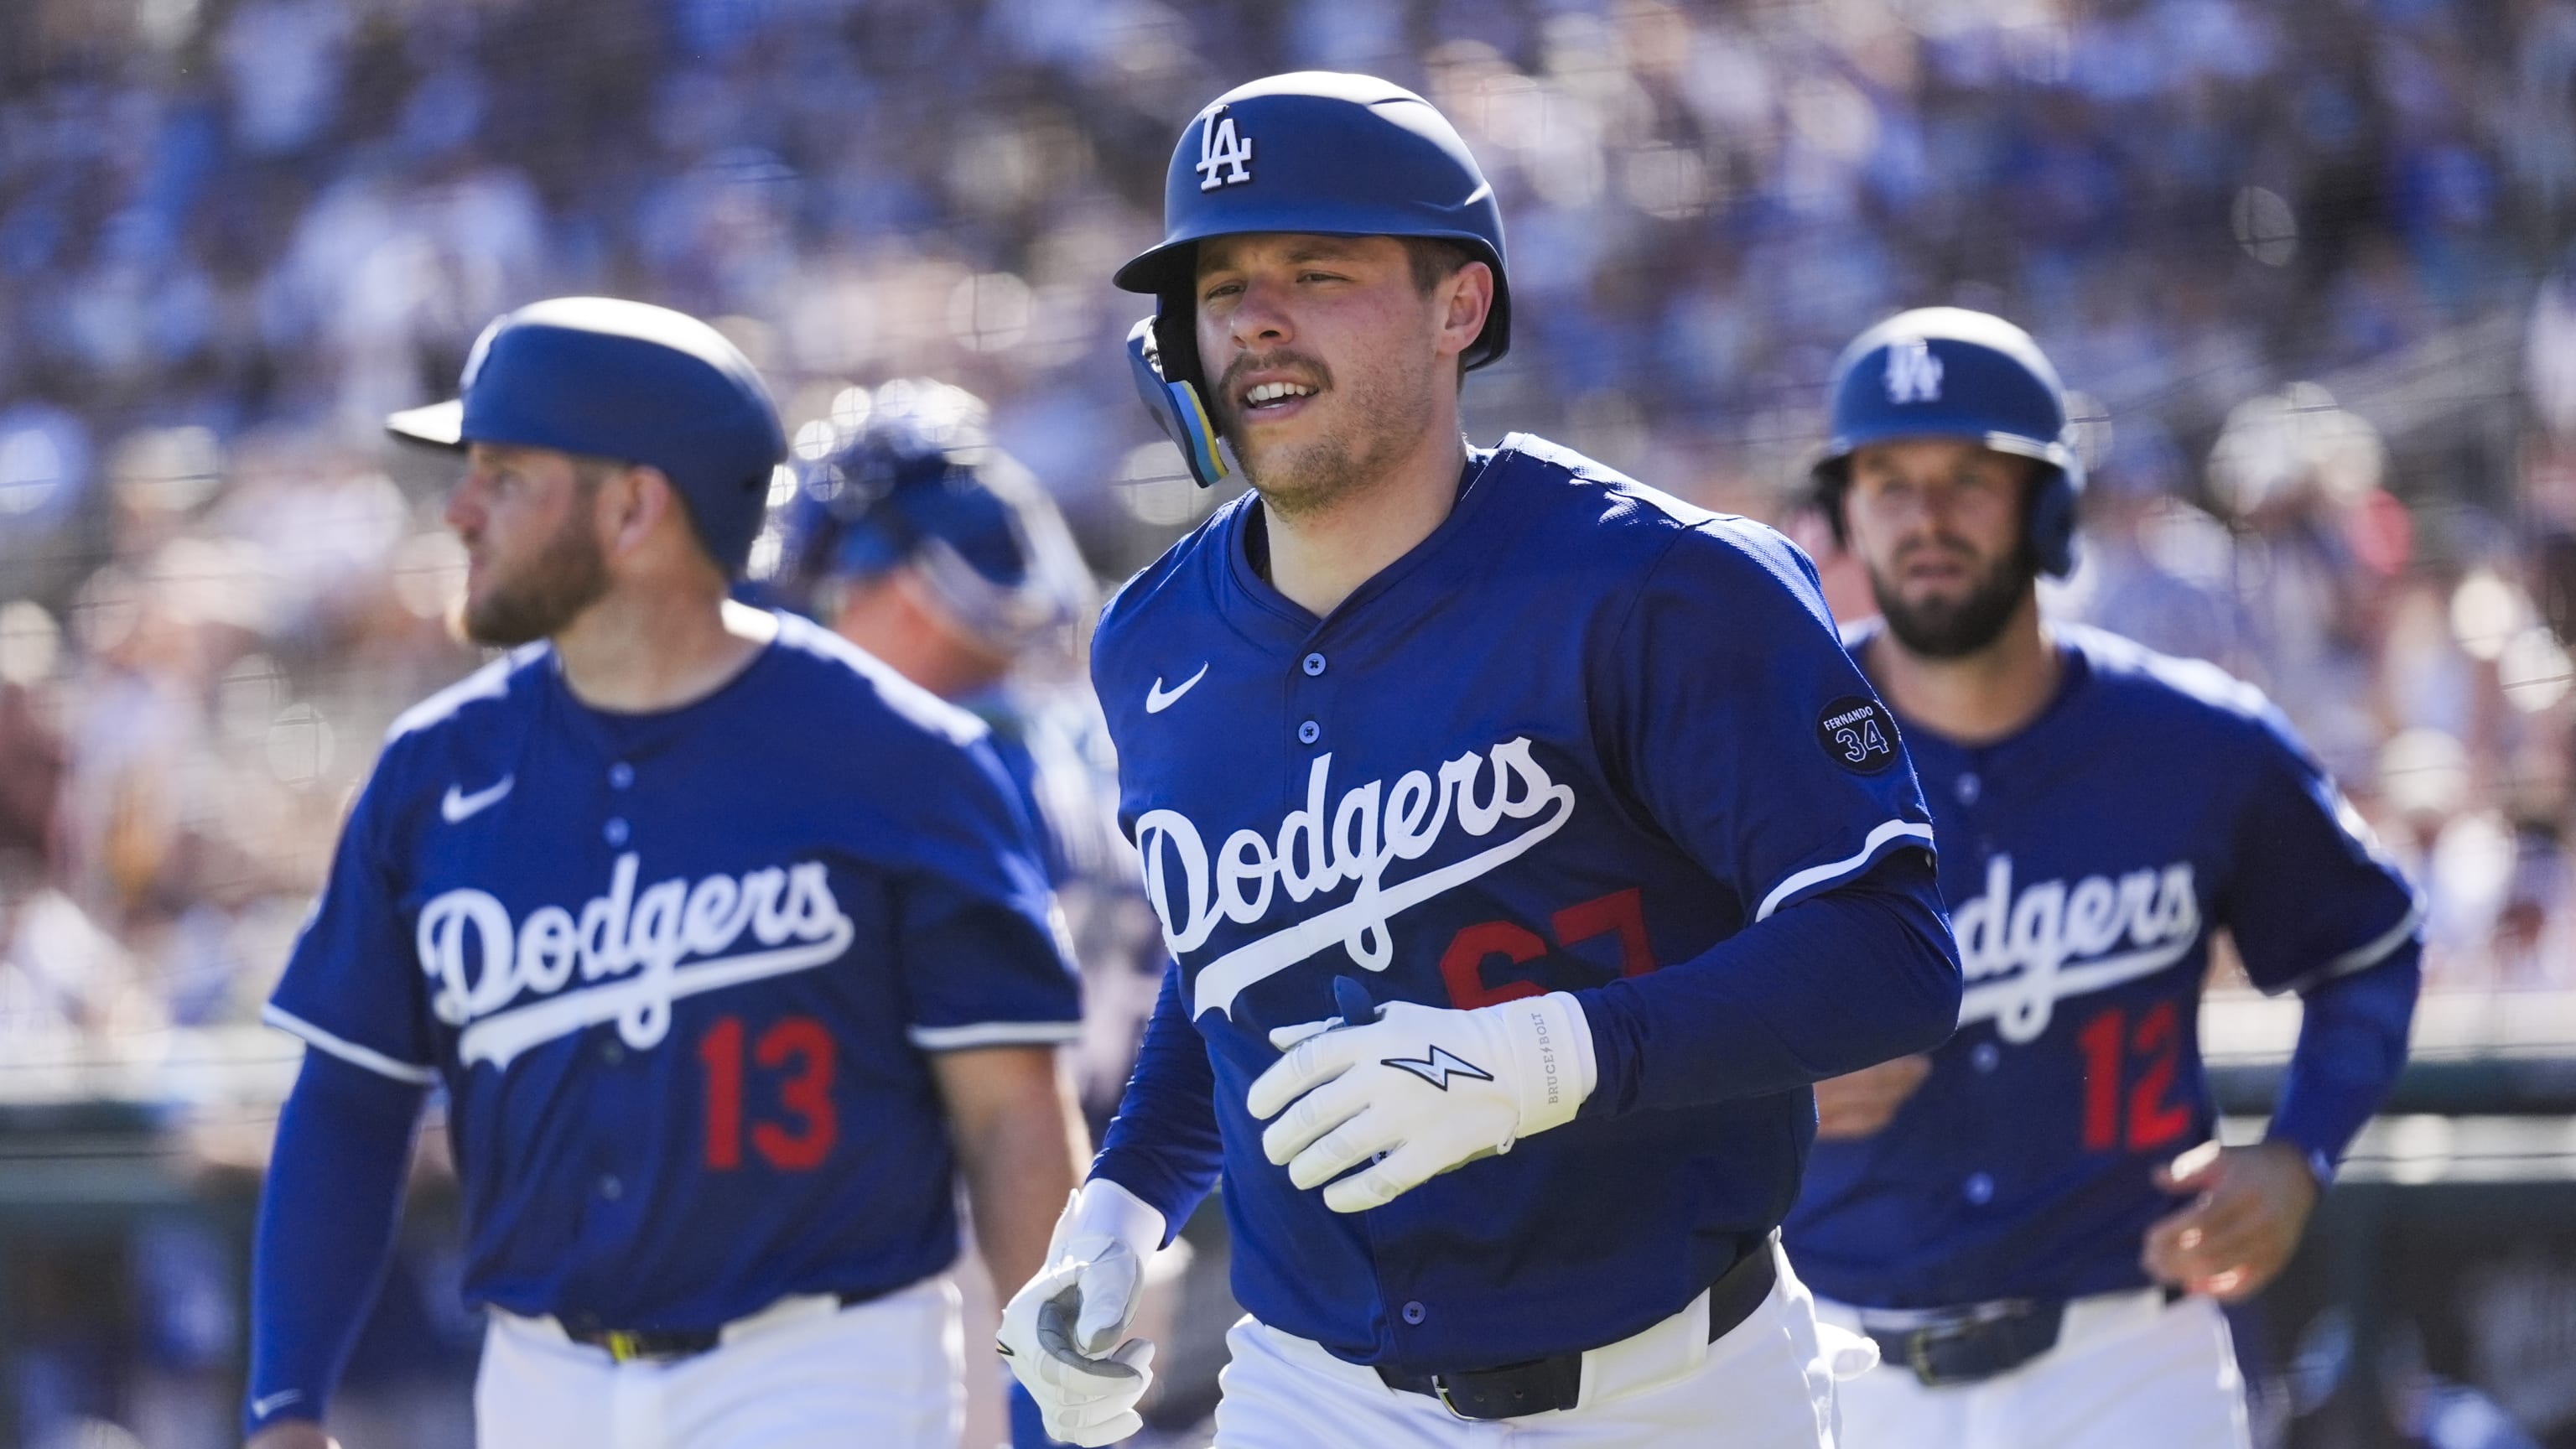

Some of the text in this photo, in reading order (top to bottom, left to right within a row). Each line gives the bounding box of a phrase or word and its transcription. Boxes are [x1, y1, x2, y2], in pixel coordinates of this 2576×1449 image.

[1196, 104, 1252, 191] LA
[1823, 705, 1874, 731] FERNANDO
[1835, 719, 1890, 763] 34
[1135, 735, 1576, 1023] Dodgers
[1950, 851, 2203, 1045] dgers
[417, 850, 855, 1072] Dodgers
[699, 1015, 836, 1171] 13
[2078, 1000, 2193, 1153] 12
